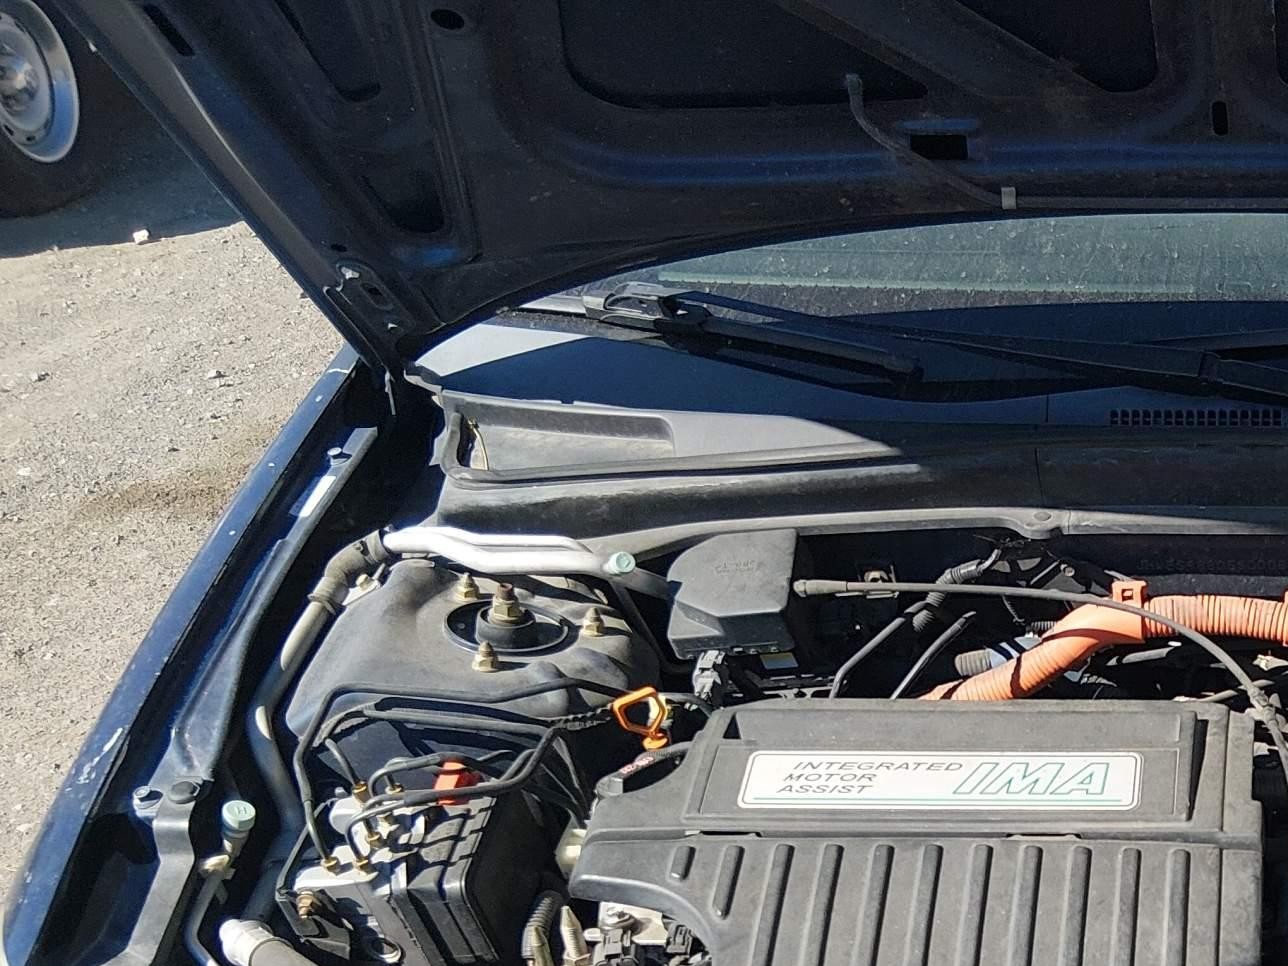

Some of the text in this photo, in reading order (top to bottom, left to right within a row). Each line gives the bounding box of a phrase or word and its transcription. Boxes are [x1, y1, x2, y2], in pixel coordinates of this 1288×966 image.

[793, 761, 963, 771] INTEGRATED
[783, 773, 877, 782] MOTOR
[953, 762, 1109, 796] IMA
[776, 784, 873, 794] ASSIST
